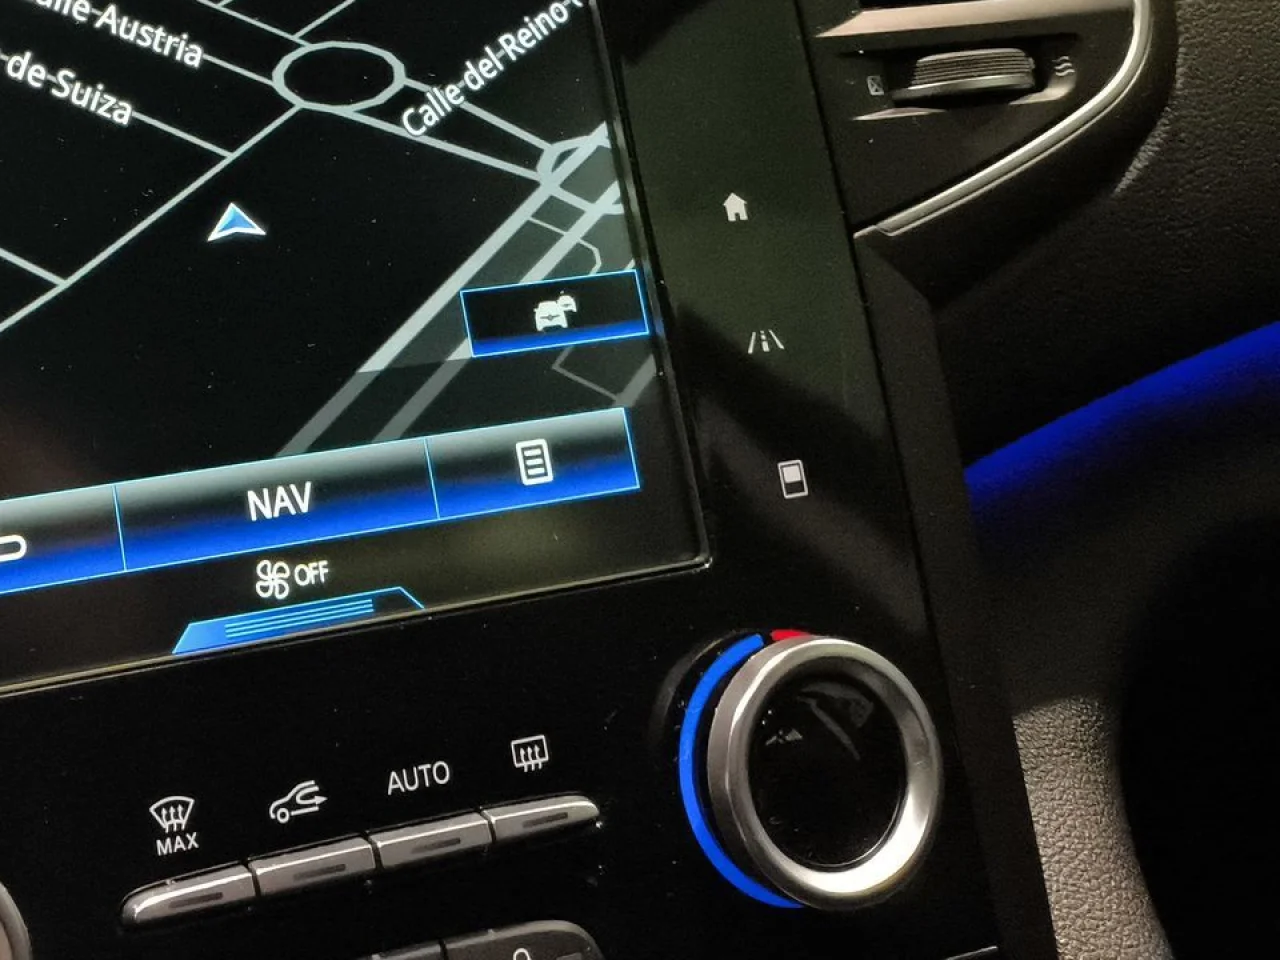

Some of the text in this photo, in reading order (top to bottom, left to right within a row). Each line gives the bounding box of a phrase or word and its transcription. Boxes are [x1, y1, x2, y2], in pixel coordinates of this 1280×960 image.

[94, 4, 204, 69] Austria
[7, 51, 47, 88] de
[51, 69, 132, 125] Suiza
[402, 82, 465, 136] Calle
[464, 45, 504, 90] del
[498, 1, 569, 61] Reino
[247, 481, 312, 522] NAV
[294, 560, 329, 586] OFF
[386, 760, 450, 796] AUTO
[156, 831, 200, 856] MAX
